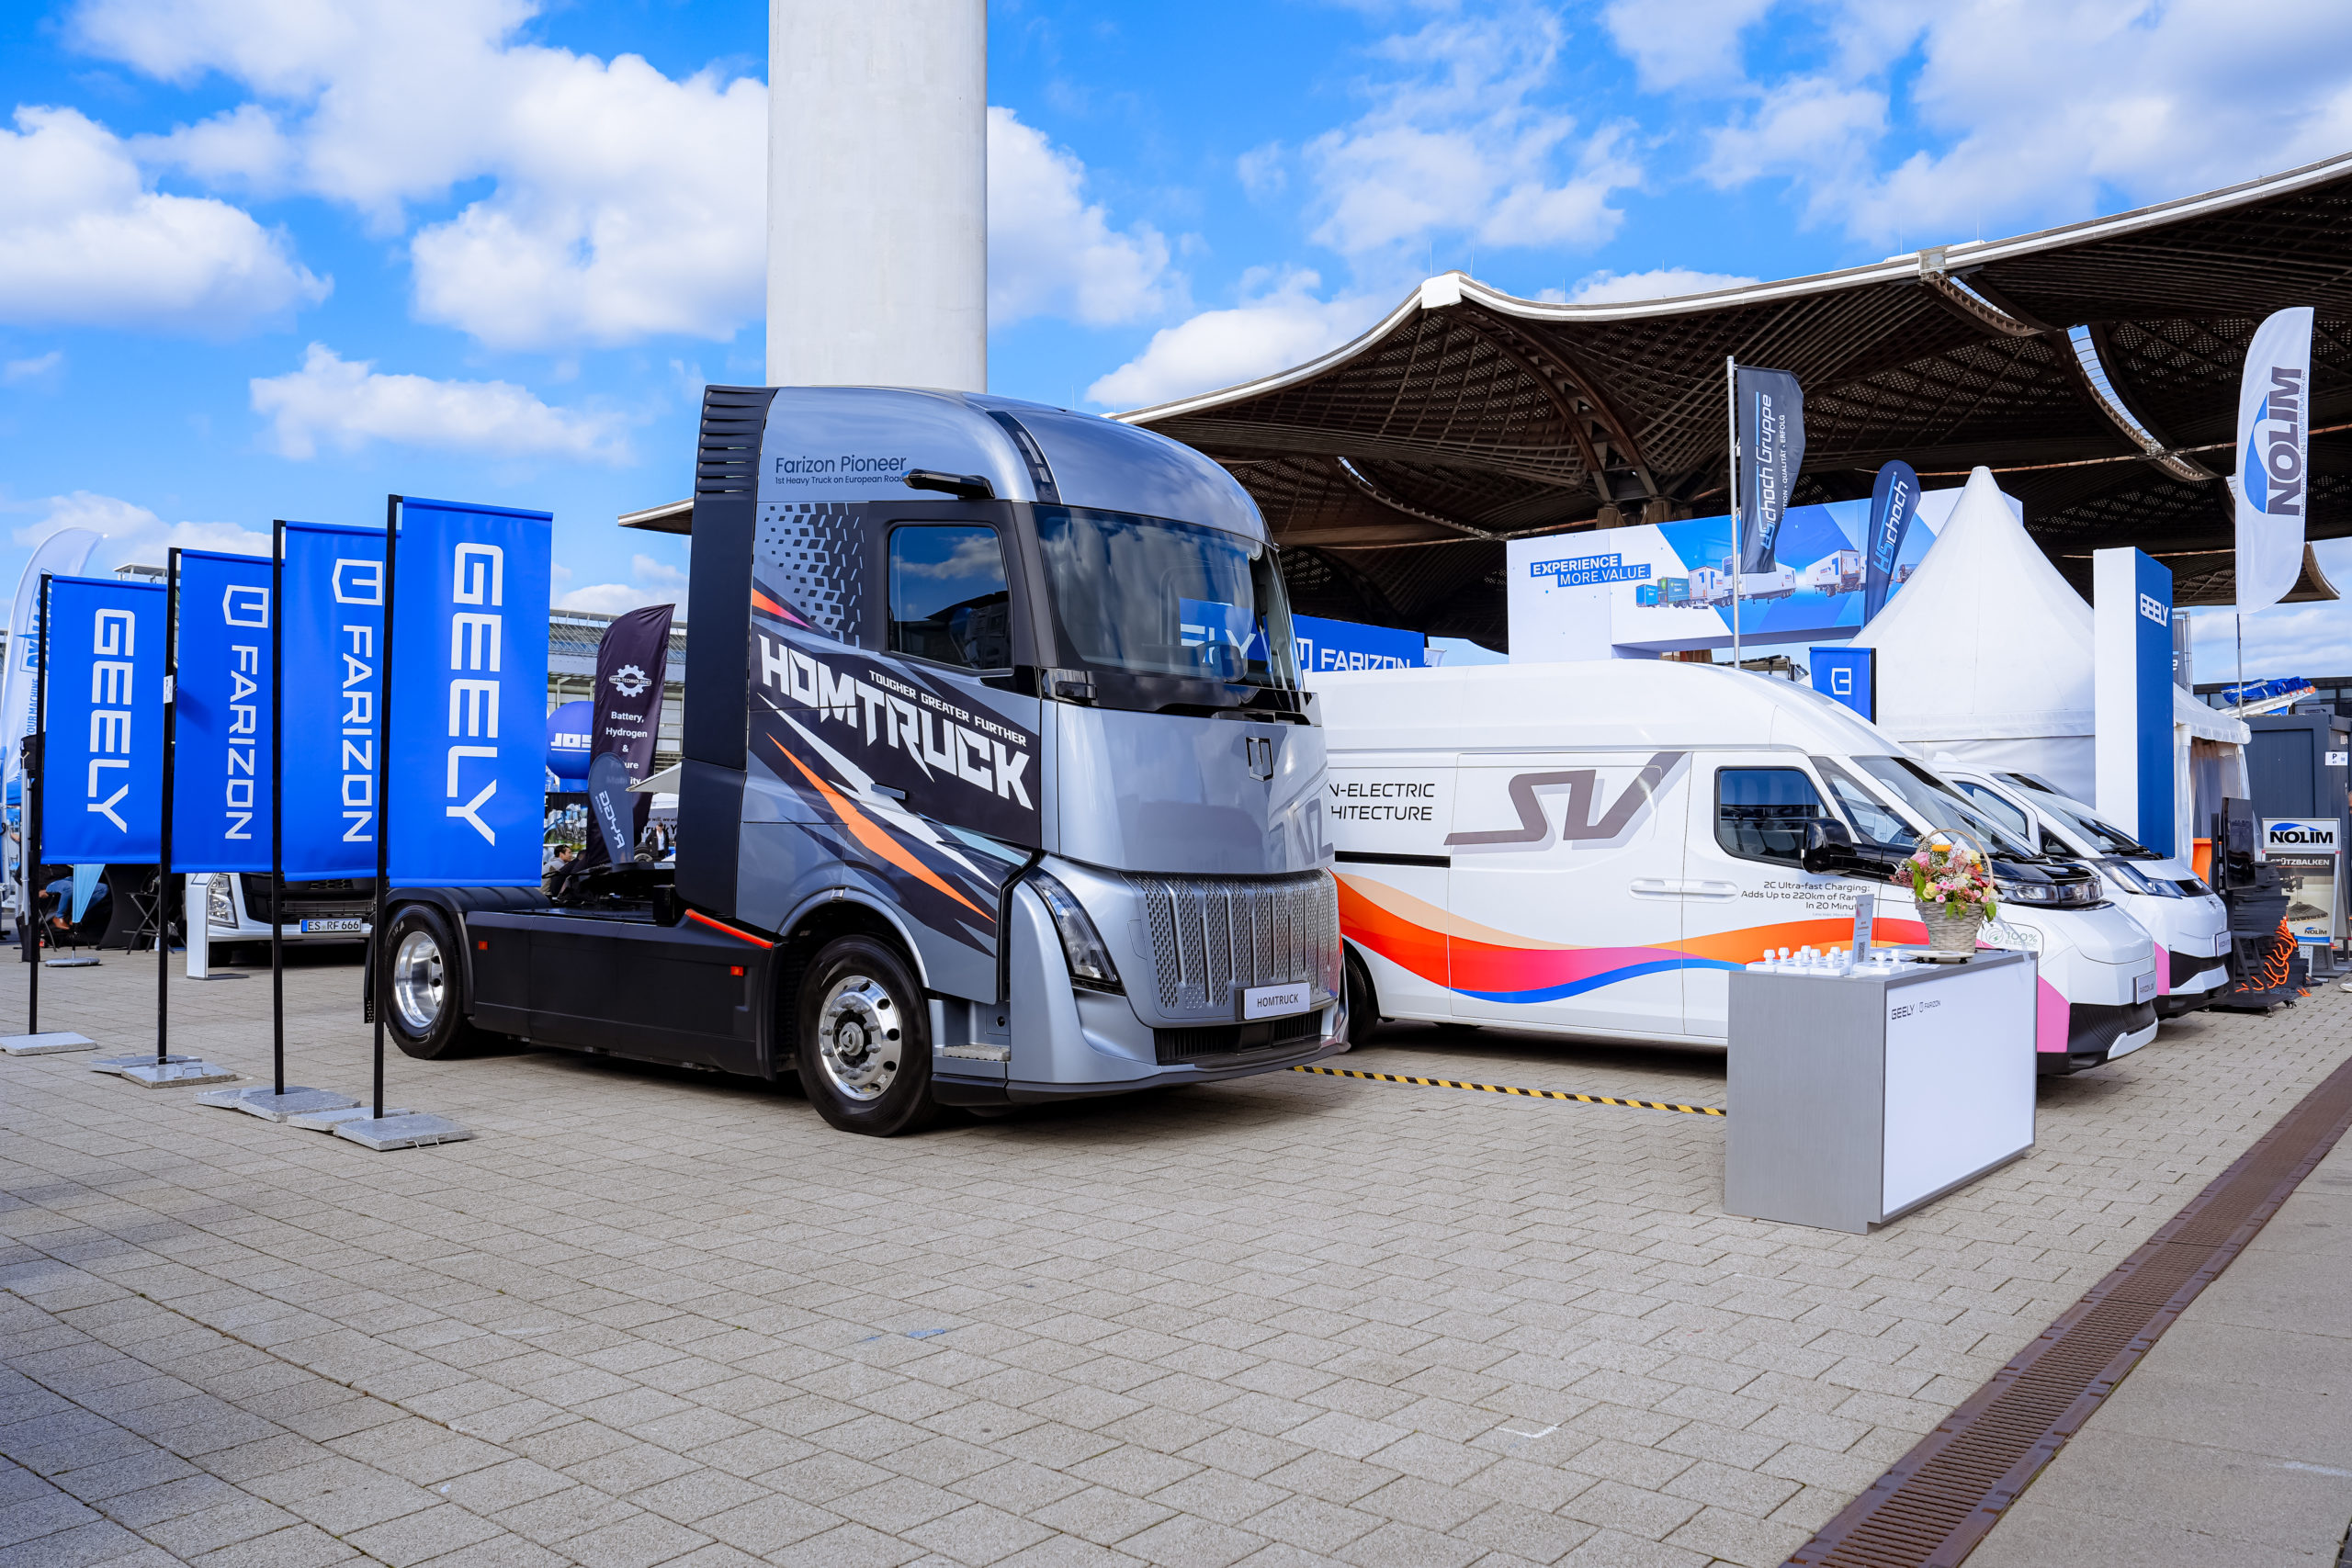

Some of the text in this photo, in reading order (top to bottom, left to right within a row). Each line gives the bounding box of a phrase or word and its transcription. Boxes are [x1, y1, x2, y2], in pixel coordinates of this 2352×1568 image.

[1757, 394, 1776, 464] Gruppe
[2267, 367, 2301, 516] NOLIM
[775, 455, 907, 473] Farizon Pioneer
[1780, 449, 1788, 484] QUALITÄT
[786, 477, 809, 486] Heavy
[812, 476, 831, 484] Truck
[845, 475, 882, 485] European
[1532, 555, 1619, 575] EXPERIENCE
[2140, 592, 2168, 626] GEELY
[446, 542, 503, 847] GEELY
[611, 711, 645, 723] Battery,
[868, 670, 1026, 747] TOUGHER GREATER FURTHER
[87, 608, 136, 834] GEELY
[758, 634, 1034, 810] HOMTRUCK
[342, 625, 373, 842] FARIZON
[605, 727, 648, 739] Hydrogen
[225, 645, 258, 840] FARIZON
[622, 744, 628, 752] &
[1331, 806, 1432, 820] HITECTURE
[2269, 831, 2334, 844] NOLIM
[1741, 890, 1764, 898] Adds
[1766, 891, 1780, 900] Up
[1792, 892, 1826, 900] 220km
[1827, 892, 1838, 900] of
[1779, 882, 1823, 890] Ultra-fast
[1825, 883, 1871, 893] Charging:
[308, 920, 359, 931] ES RF 666
[2007, 931, 2038, 942] 100%
[1257, 993, 1299, 1008] HOMTRUCK
[1892, 1004, 1916, 1021] GEELY
